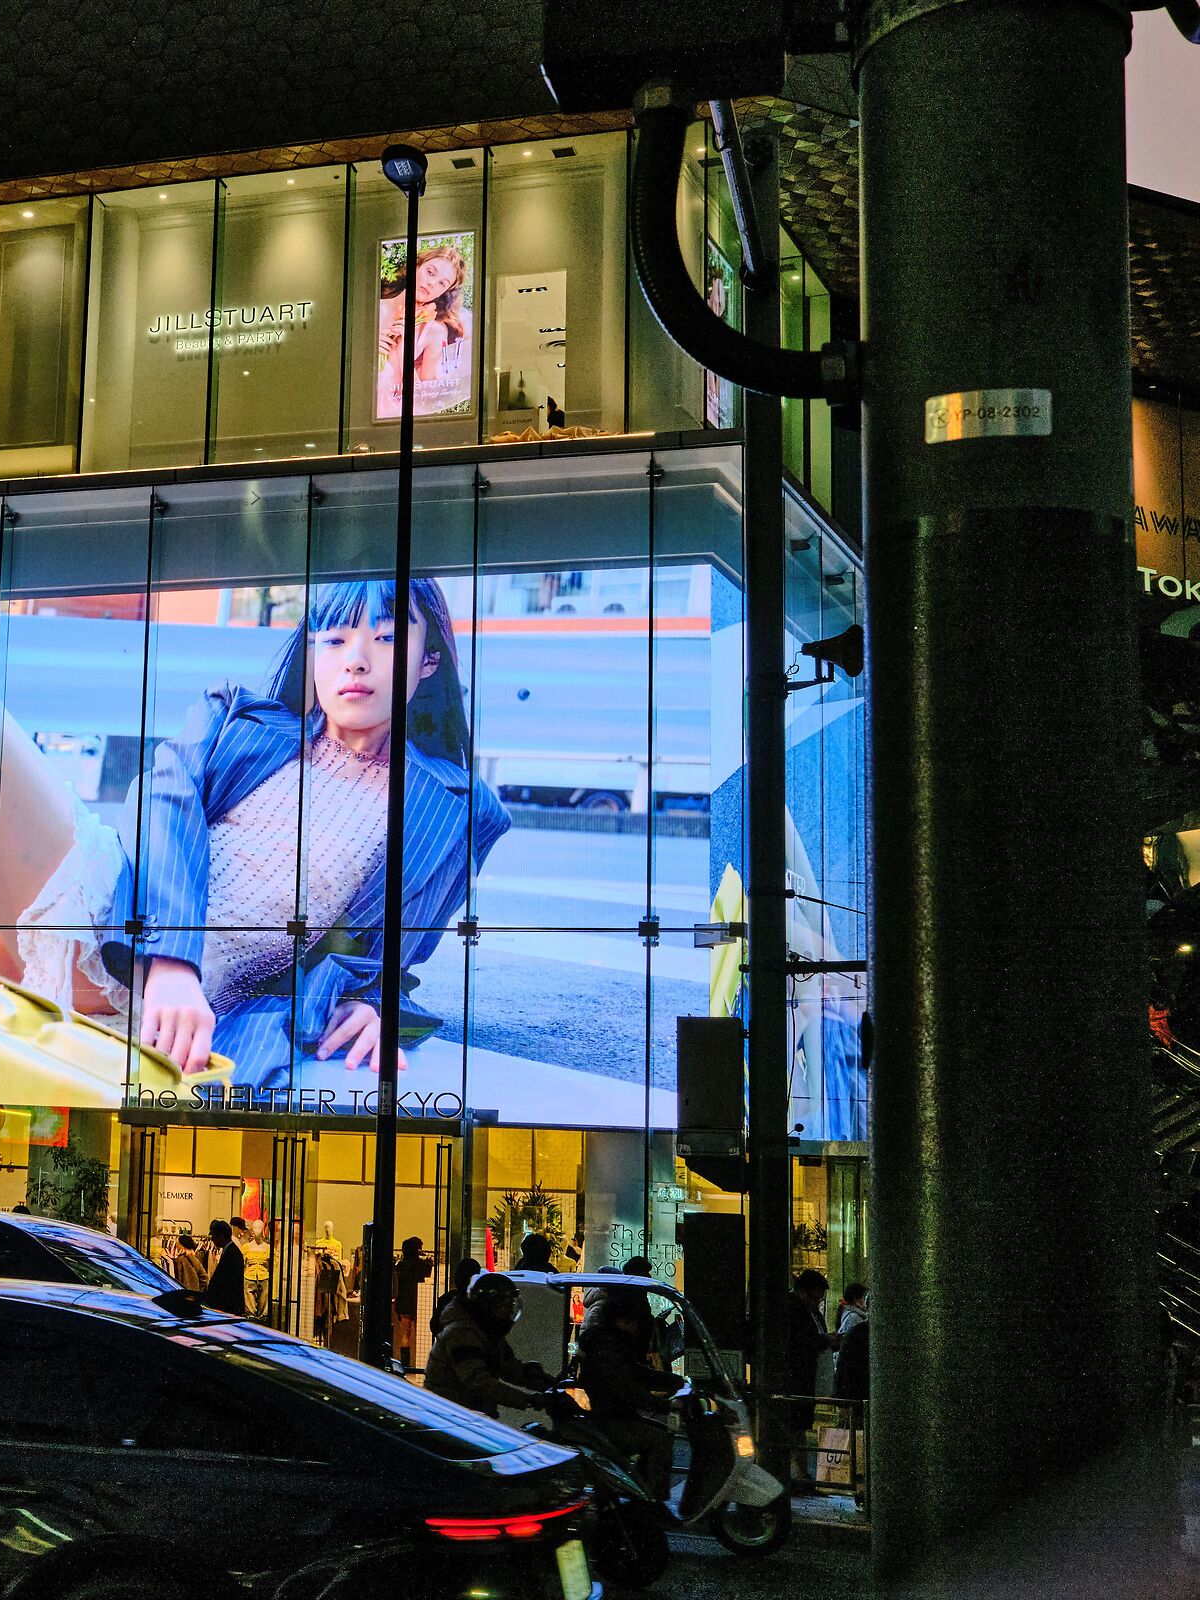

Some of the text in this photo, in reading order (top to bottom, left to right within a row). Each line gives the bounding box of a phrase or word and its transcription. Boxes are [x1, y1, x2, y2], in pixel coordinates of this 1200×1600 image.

[149, 302, 311, 333] JILLSTUART
[224, 335, 233, 346] &
[238, 331, 284, 344] PARTY
[121, 1082, 178, 1109] The
